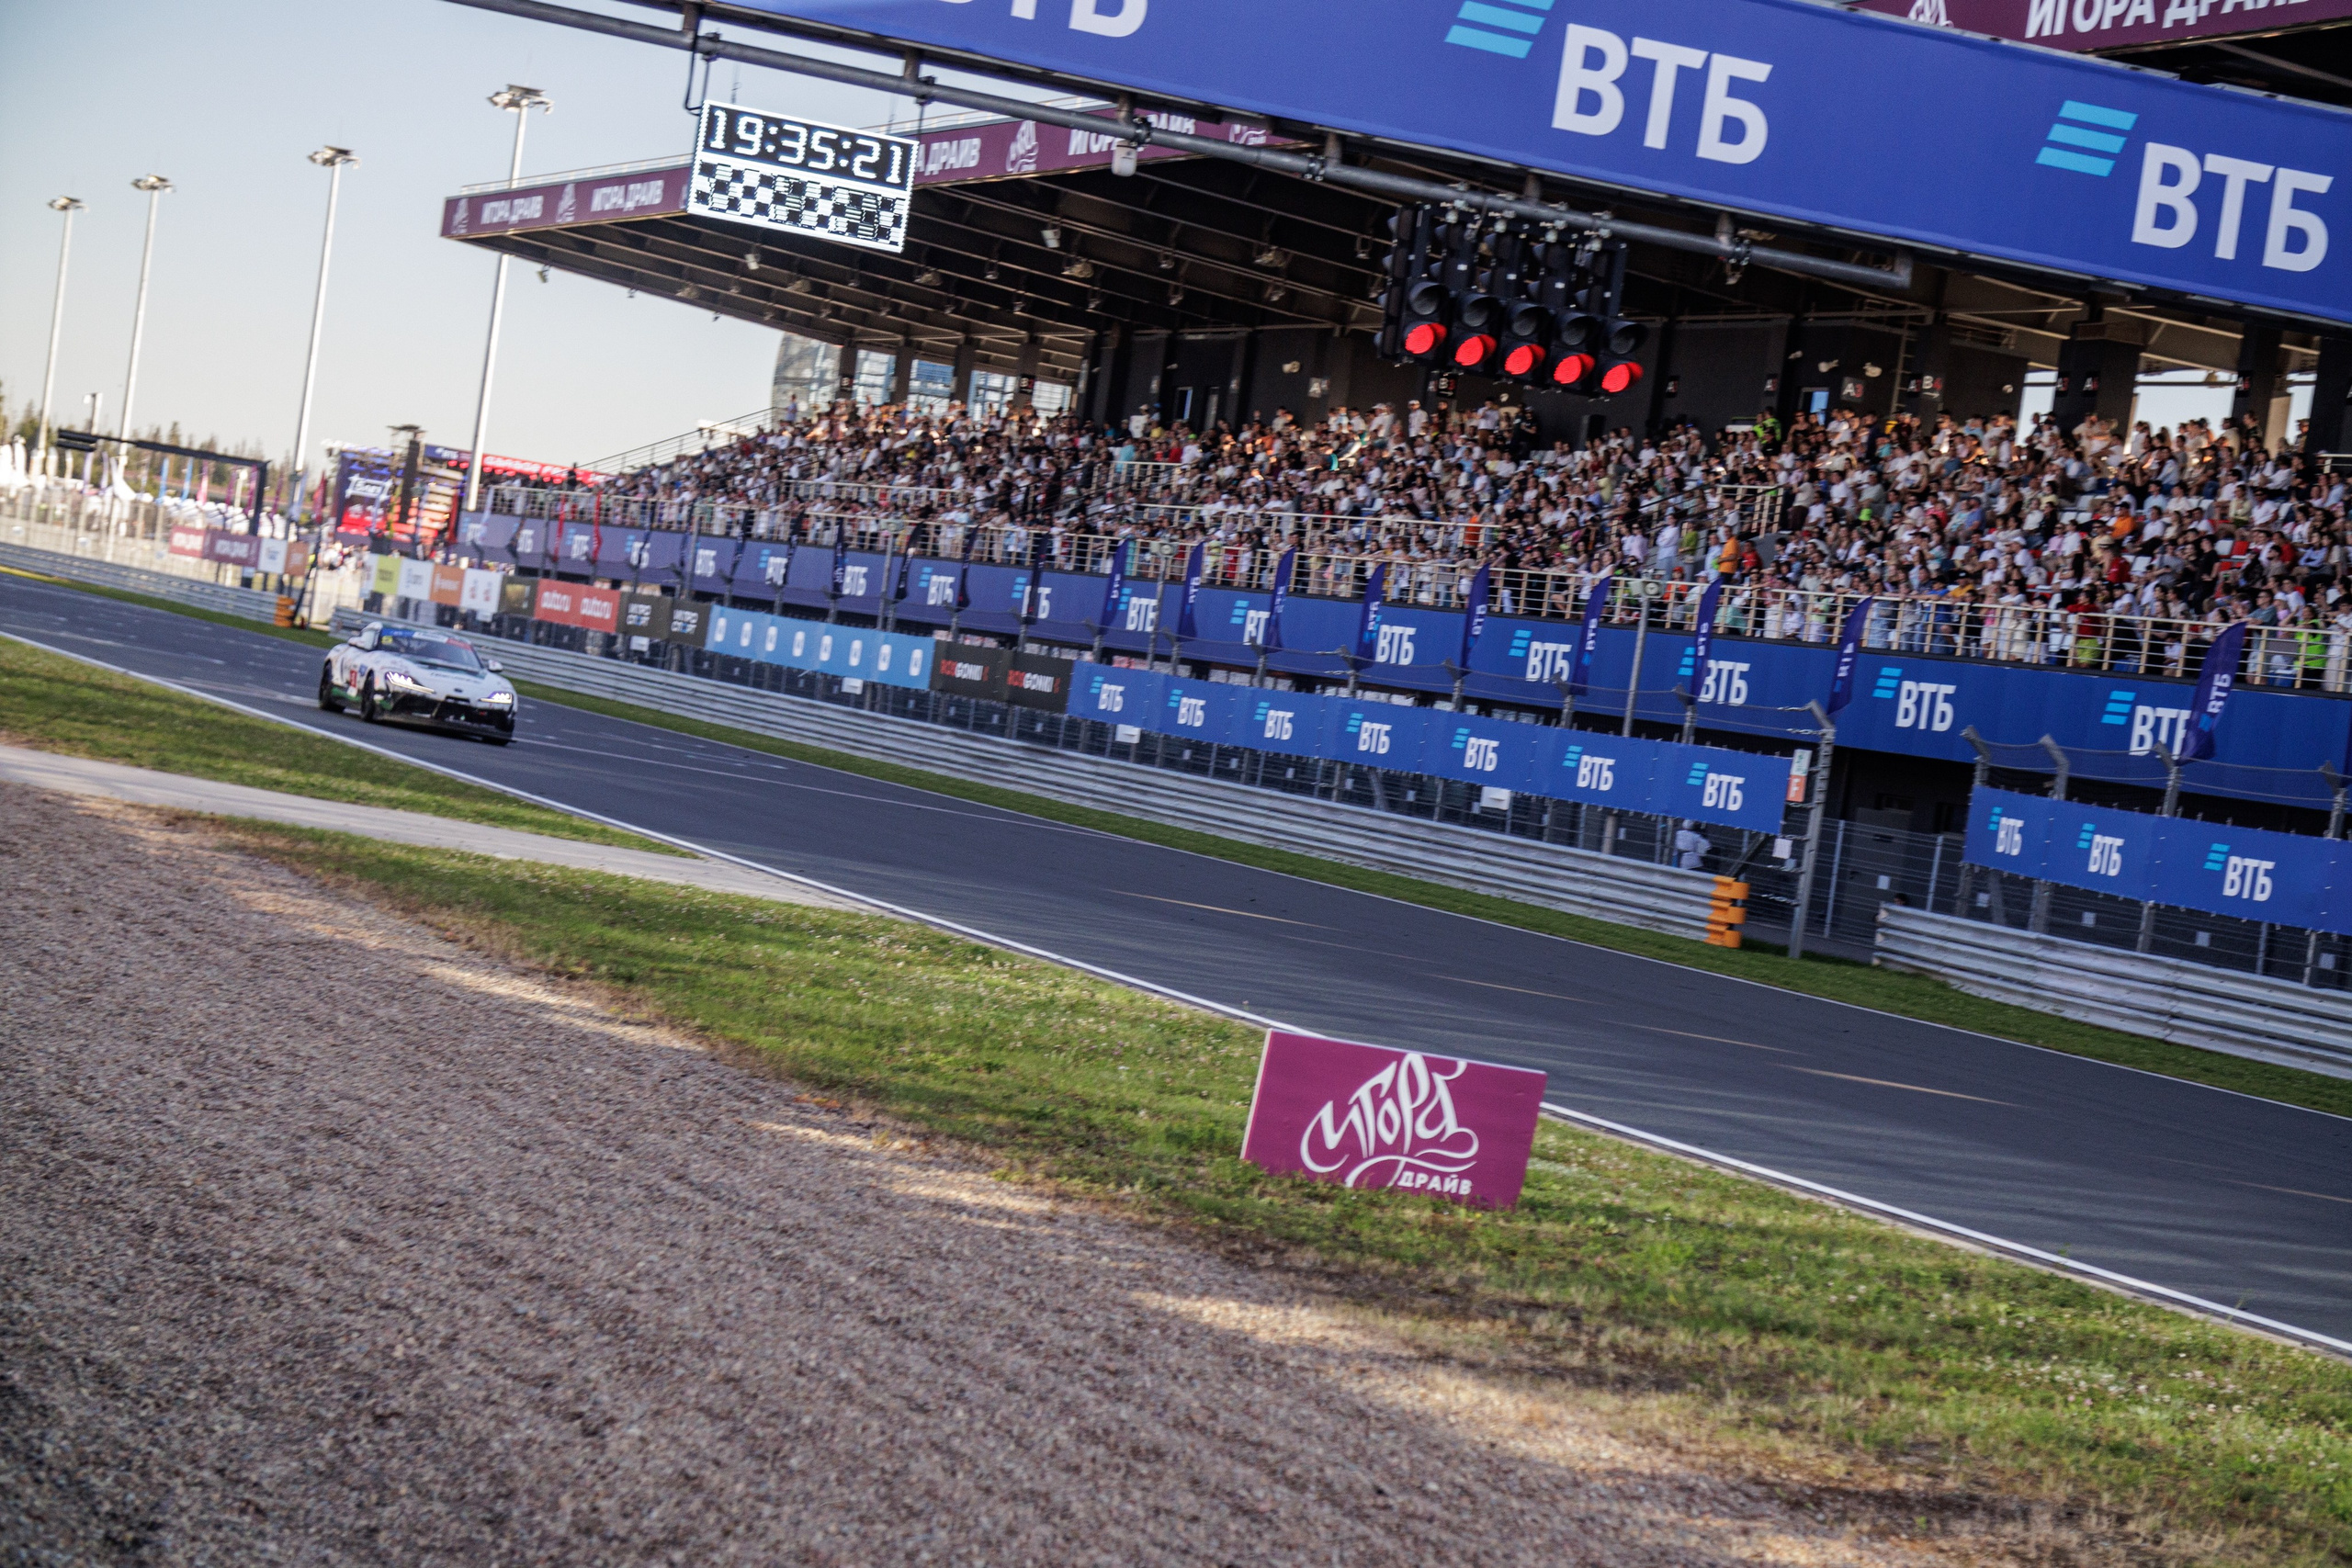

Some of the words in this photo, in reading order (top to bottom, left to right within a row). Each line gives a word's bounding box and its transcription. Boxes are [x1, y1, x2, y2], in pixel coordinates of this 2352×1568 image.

[1552, 23, 1773, 164] ВТБ
[709, 109, 902, 183] 19:35:21
[2132, 141, 2334, 272] ВТБ
[1842, 382, 1863, 398] A3
[1922, 375, 1942, 390] B4
[1243, 609, 1272, 646] ВТ
[1375, 624, 1417, 666] ВТБ
[1526, 641, 1572, 683] ВТБ
[1098, 683, 1125, 713] ВТБ
[1698, 660, 1750, 706] ВТБ
[2207, 673, 2232, 714] ВТБ
[1177, 696, 1206, 728] ВТБ
[1263, 709, 1295, 740] ВТБ
[1895, 680, 1957, 732] ВТБ
[1358, 721, 1392, 754] ВТБ
[1464, 736, 1499, 772] ВТБ
[1577, 755, 1615, 792] ВТБ
[1702, 773, 1745, 811] ВТБ
[1996, 817, 2024, 856] ВТБ
[2087, 834, 2124, 876] ВТБ
[2222, 855, 2276, 902] ВТБ
[1397, 1170, 1474, 1196] ДРАЙВ
